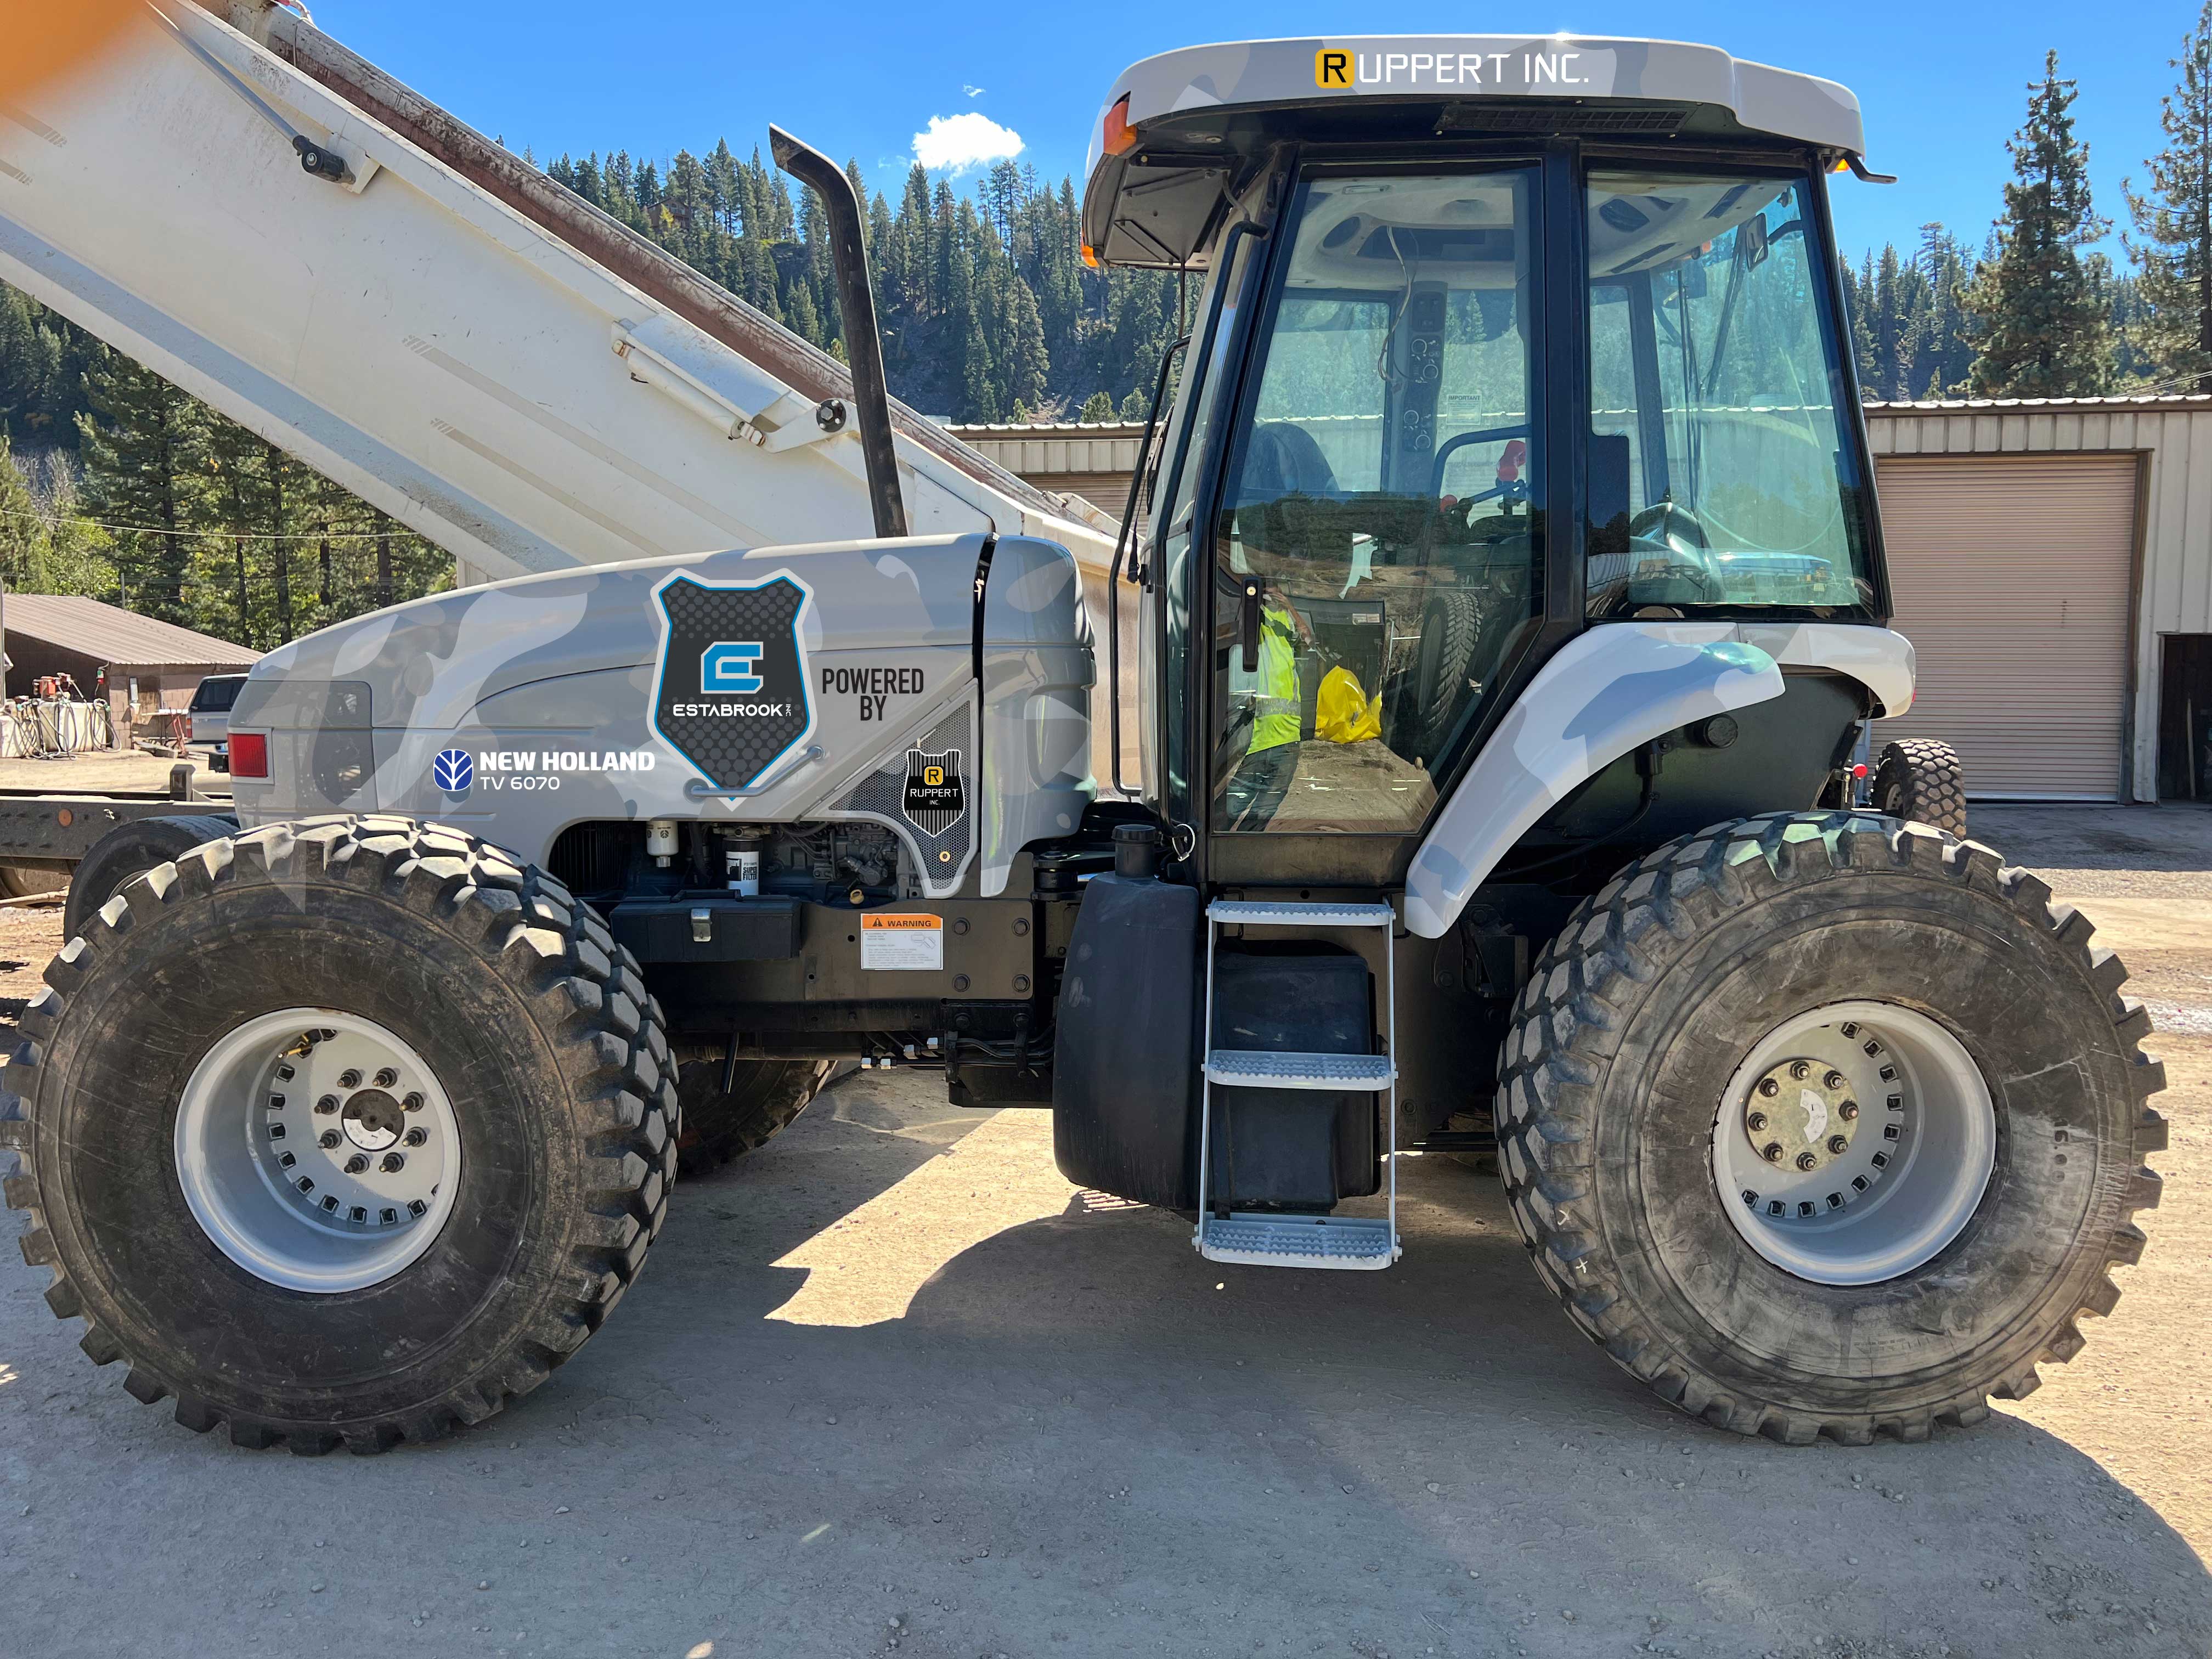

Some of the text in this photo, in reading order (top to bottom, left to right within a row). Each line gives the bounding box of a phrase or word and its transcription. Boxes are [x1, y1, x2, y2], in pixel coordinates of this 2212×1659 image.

[1323, 53, 1589, 83] RUPPERT INC.
[822, 668, 924, 694] POWERED
[673, 704, 783, 716] ESTABROOK
[860, 695, 887, 721] BY
[480, 752, 655, 771] NEW HOLLAND
[480, 776, 560, 790] TV 6070
[928, 769, 939, 782] R
[910, 788, 958, 797] RUPPERT
